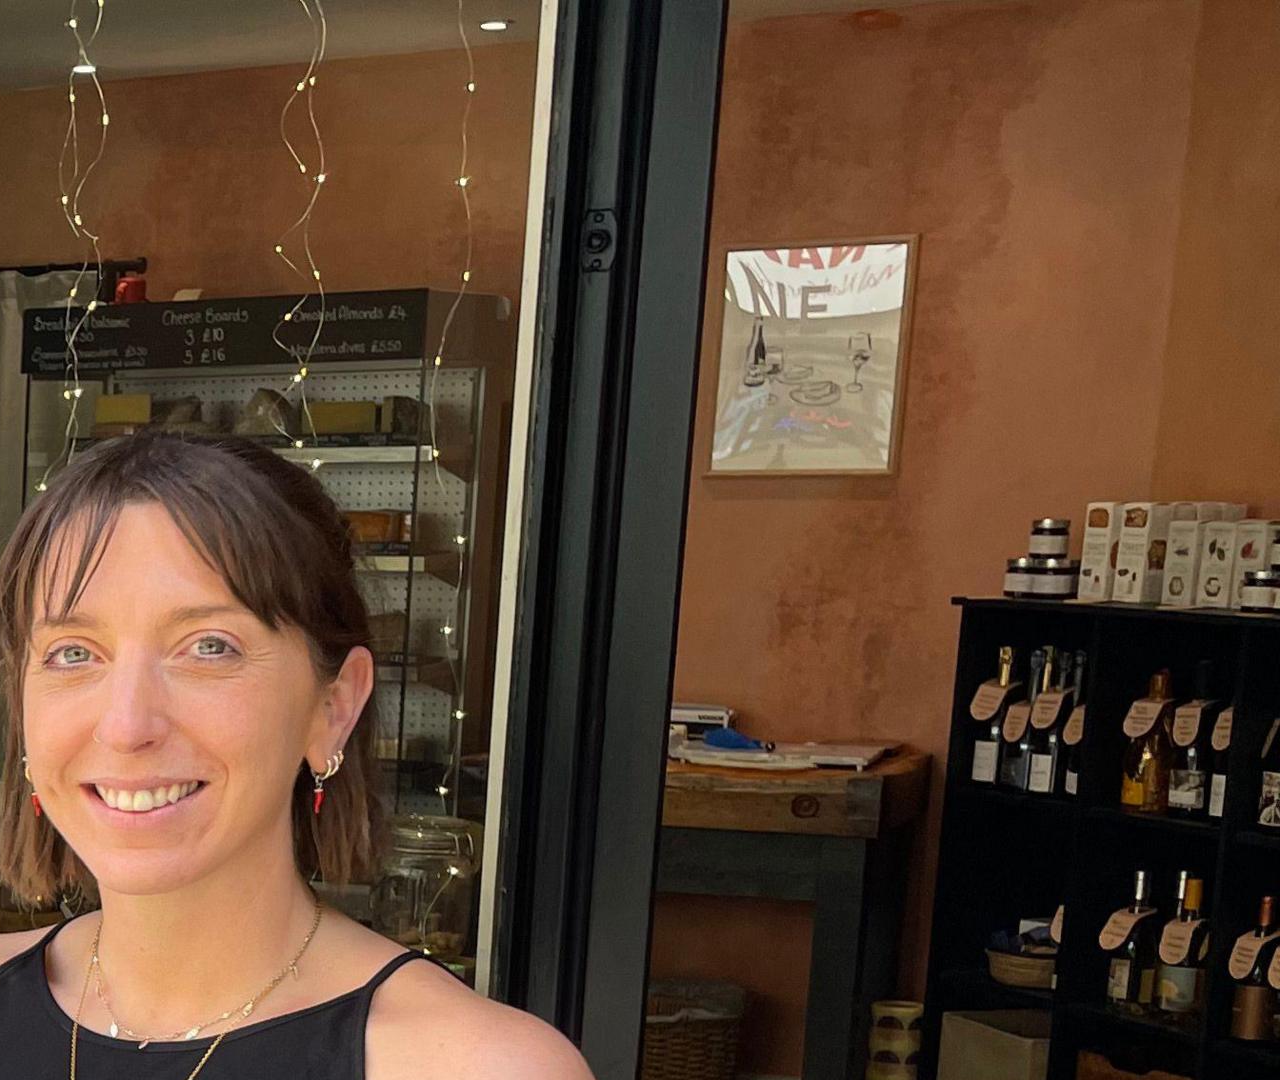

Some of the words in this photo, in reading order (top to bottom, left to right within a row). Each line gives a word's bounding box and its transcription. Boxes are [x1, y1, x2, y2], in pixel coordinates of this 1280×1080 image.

[162, 310, 202, 326] Cheese
[205, 307, 248, 323] Boards
[202, 327, 225, 342] £10
[201, 348, 226, 363] £16
